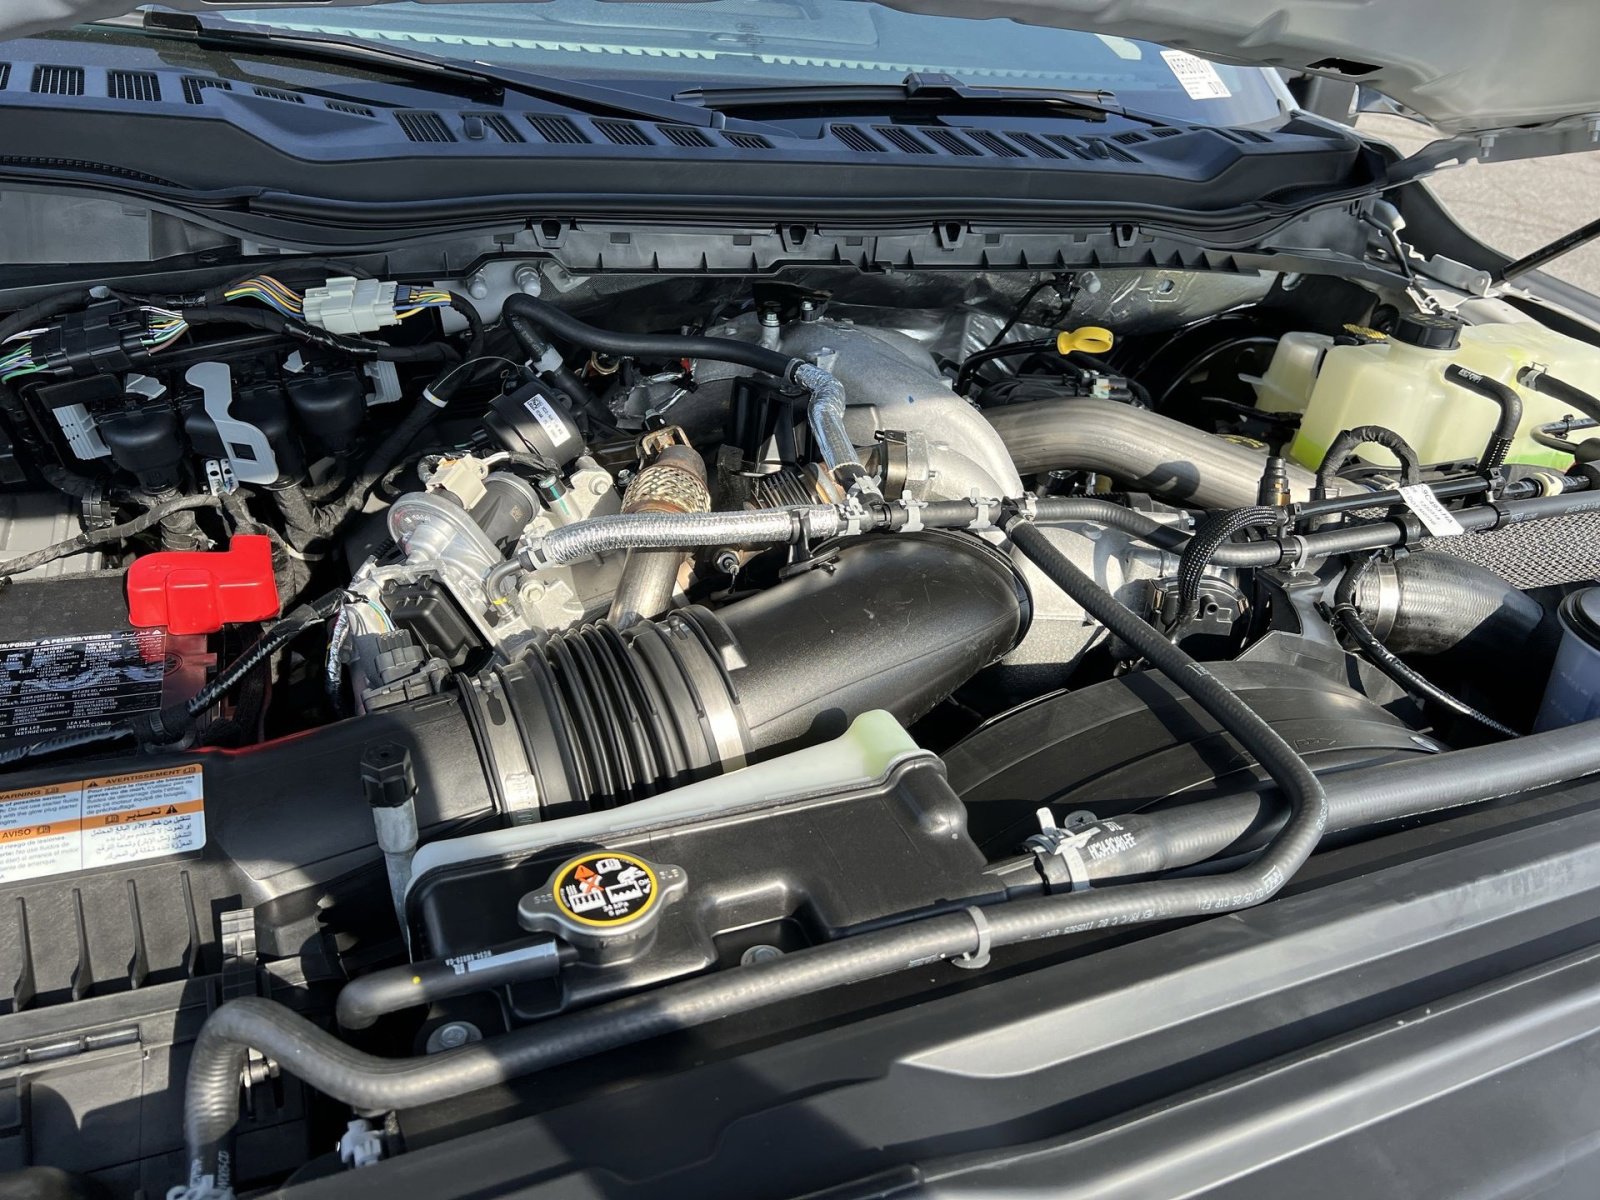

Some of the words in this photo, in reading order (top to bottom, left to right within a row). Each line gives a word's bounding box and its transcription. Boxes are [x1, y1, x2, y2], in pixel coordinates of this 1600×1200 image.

[51, 634, 112, 645] PELIGRO/VENENO
[0, 641, 37, 650] ER/POISON
[14, 727, 57, 736] INSTRUCTIONS
[104, 768, 180, 786] AVERTISSEMENT
[13, 798, 41, 807] possible
[2, 828, 31, 839] AVISO
